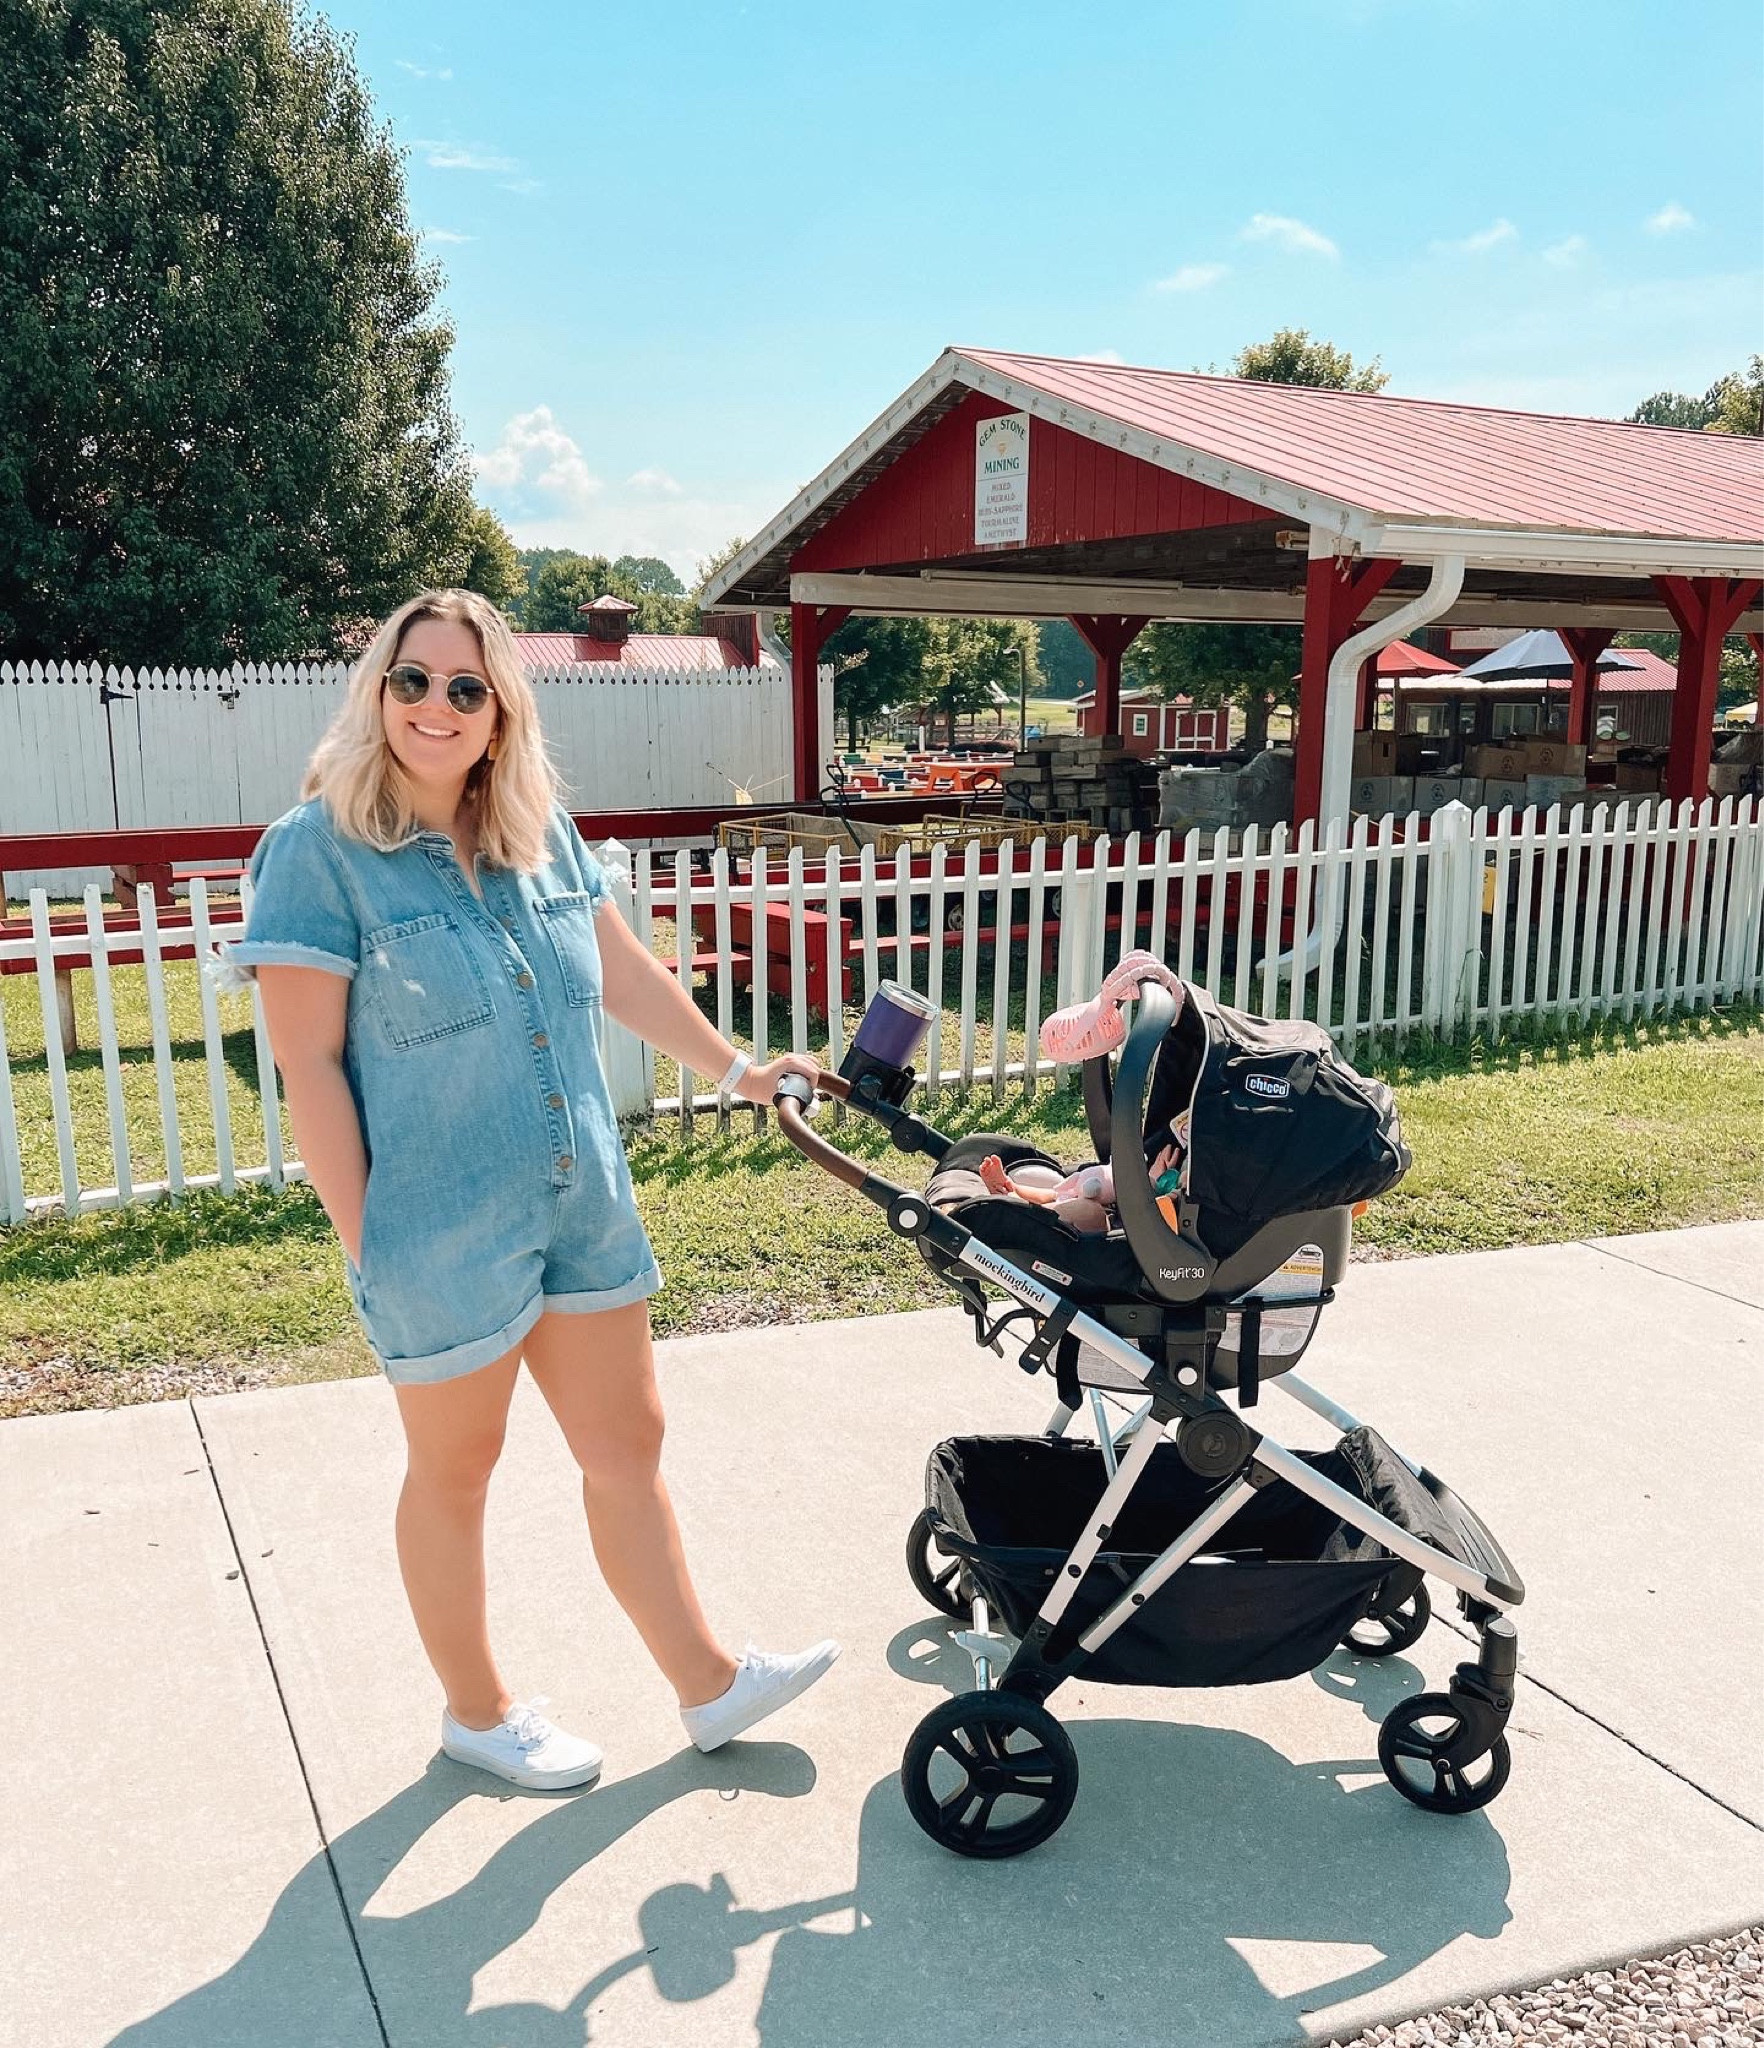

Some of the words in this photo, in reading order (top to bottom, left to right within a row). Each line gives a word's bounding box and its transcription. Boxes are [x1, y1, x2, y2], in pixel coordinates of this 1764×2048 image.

[979, 423, 997, 447] GEM
[1000, 419, 1025, 441] STONE
[984, 456, 1020, 474] MINING
[986, 492, 1016, 504] EMERALD
[1250, 1077, 1287, 1095] chicco
[974, 1253, 1046, 1303] mockingbird
[1159, 1267, 1189, 1281] KeyFit
[1191, 1267, 1205, 1279] 30
